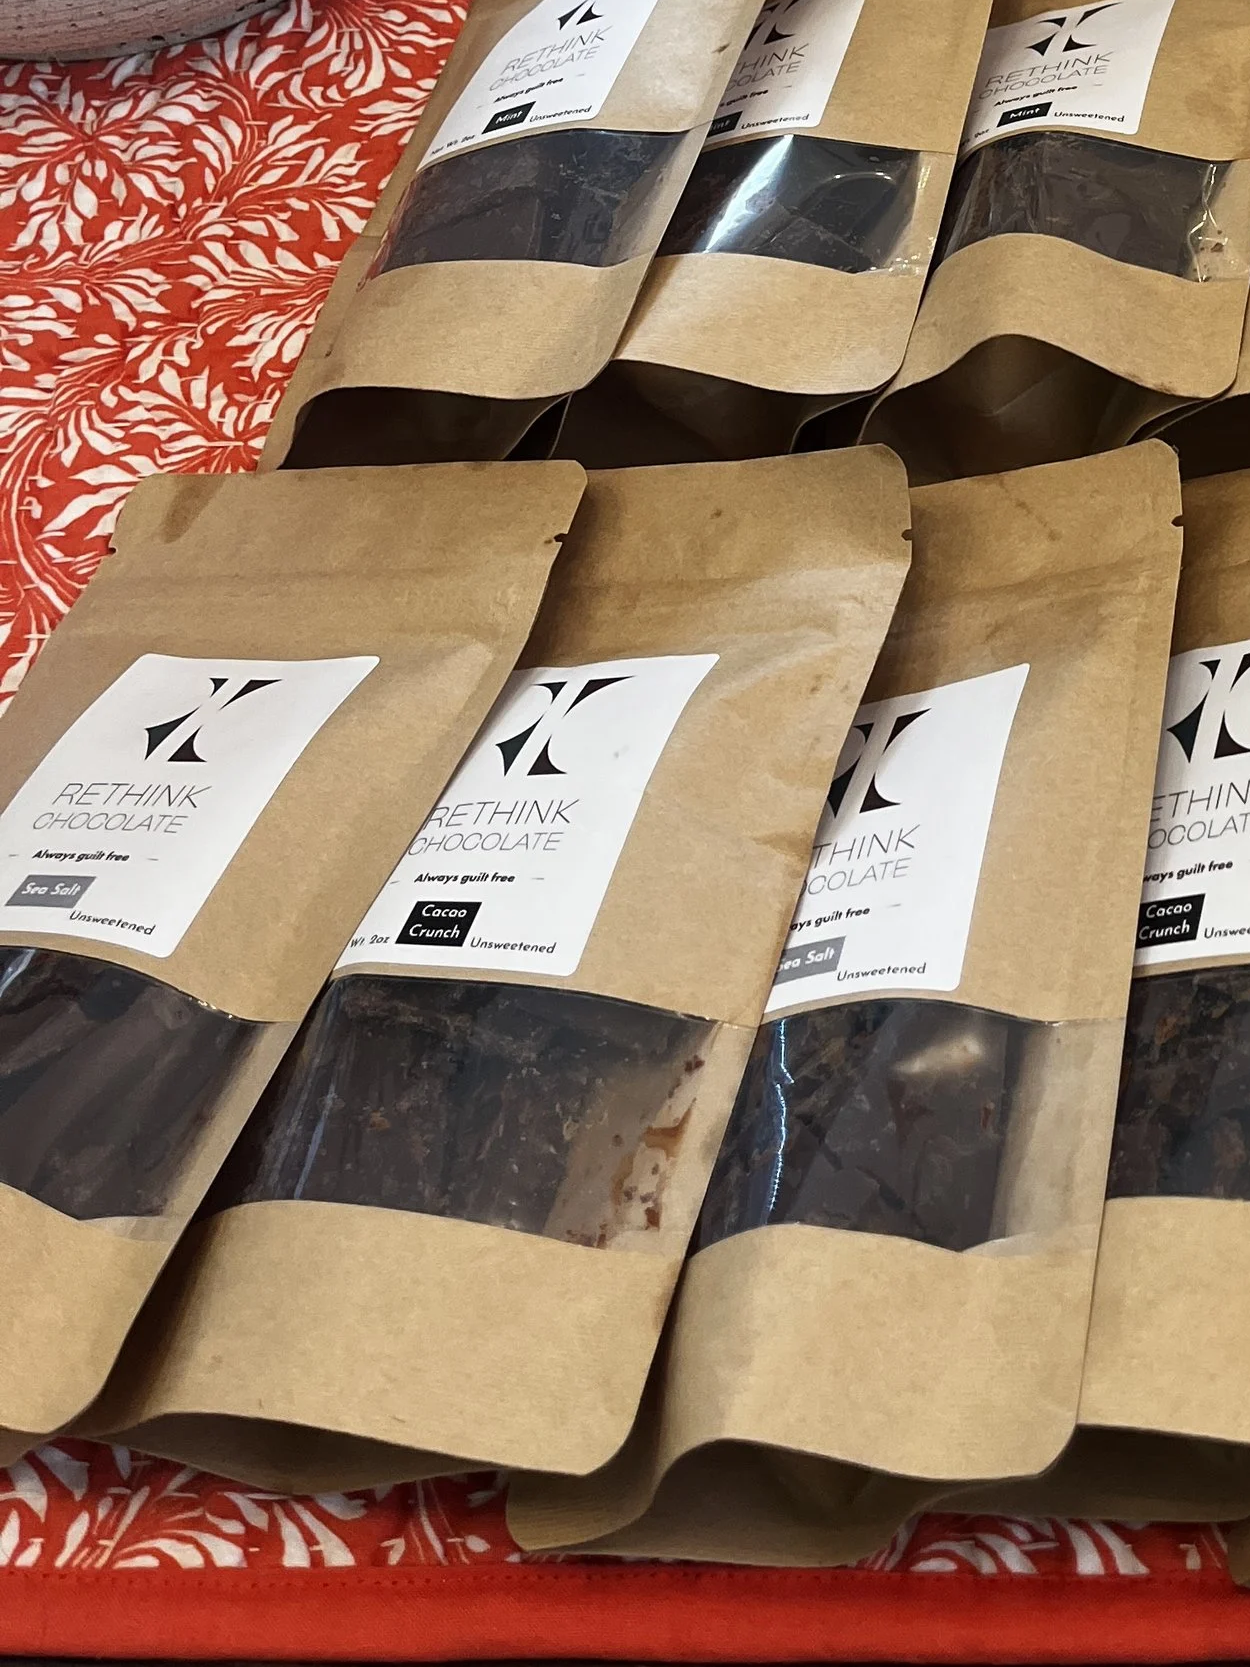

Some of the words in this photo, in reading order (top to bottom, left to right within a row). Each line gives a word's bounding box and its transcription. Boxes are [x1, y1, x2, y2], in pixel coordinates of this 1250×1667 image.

[501, 26, 613, 75] RETHINK
[738, 43, 810, 74] HINK
[489, 46, 600, 91] CHOCOLATE
[986, 51, 1115, 86] RETHINK
[978, 65, 1108, 100] CHOCOLATE
[495, 110, 523, 124] Mint
[529, 105, 593, 123] Unsweetened
[741, 113, 810, 129] Unsweetened
[1009, 107, 1041, 119] Mint
[1053, 111, 1126, 122] Unsweetened
[52, 783, 212, 808] RETHINK
[33, 812, 189, 833] CHOCOLATE
[423, 799, 580, 830] RETHINK
[408, 832, 564, 856] CHOCOLATE
[812, 824, 920, 869] THINK
[32, 849, 76, 861] Always
[76, 851, 105, 862] guilt
[106, 851, 130, 861] free
[414, 873, 459, 884] Always
[460, 872, 489, 884] guilt
[490, 873, 515, 883] free
[800, 857, 912, 896] COLATE
[1143, 871, 1173, 884] ways
[1176, 862, 1205, 880] guilt
[1208, 860, 1233, 872] free
[21, 883, 48, 895] Sea
[50, 883, 81, 896] Salt
[421, 904, 468, 918] Cacao
[790, 919, 812, 932] ays
[814, 910, 843, 928] guilt
[845, 907, 870, 919] free
[1146, 902, 1192, 918] Cacao
[69, 910, 156, 935] Unsweetened
[409, 924, 461, 939] Crunch
[1138, 919, 1191, 940] Crunch
[470, 937, 556, 954] Unsweetened
[805, 946, 835, 965] Salt
[837, 962, 926, 981] Unsweetened
